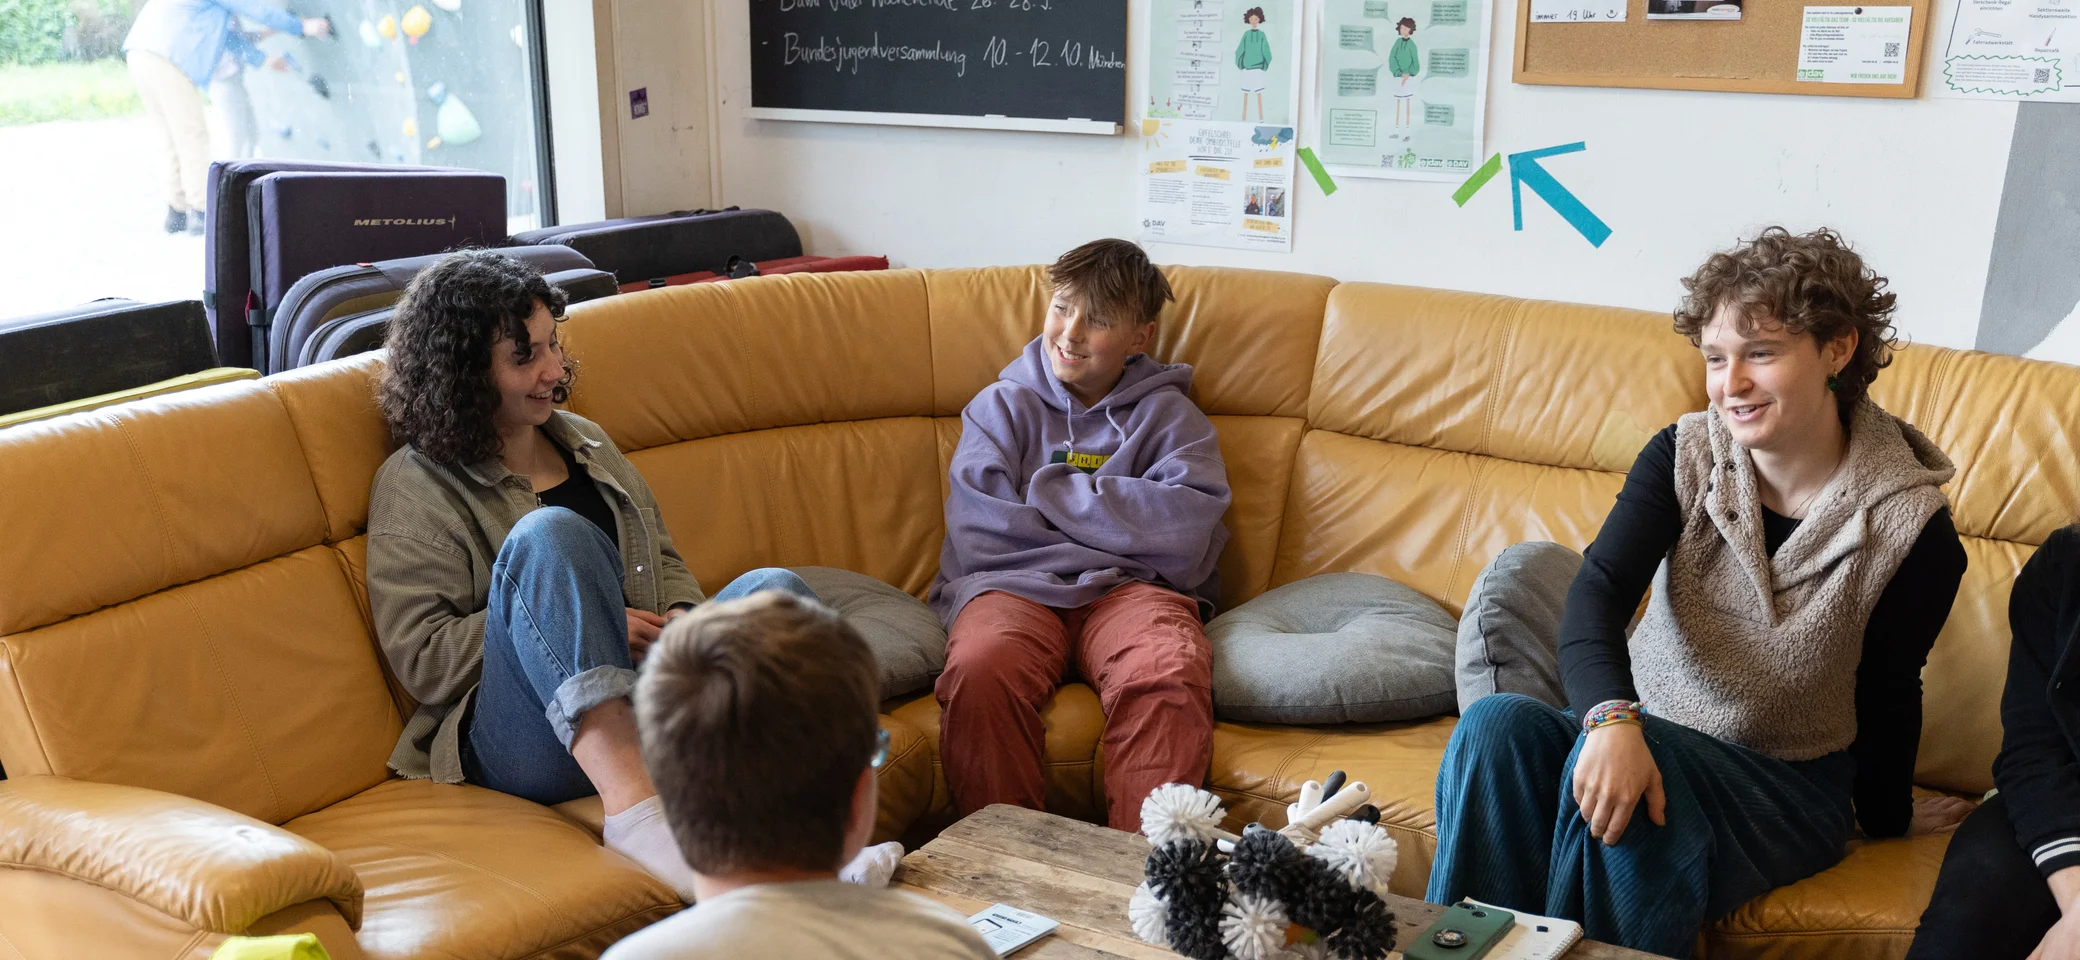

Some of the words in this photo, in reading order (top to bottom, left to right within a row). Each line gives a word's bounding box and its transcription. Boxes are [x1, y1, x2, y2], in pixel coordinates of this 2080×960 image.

[1535, 10, 1558, 20] immer
[1567, 10, 1577, 21] 19
[1583, 9, 1597, 19] Uhr
[784, 31, 968, 78] Bundesjugendversammlung
[354, 218, 446, 226] METOLIUS
[1152, 219, 1166, 227] DAV
